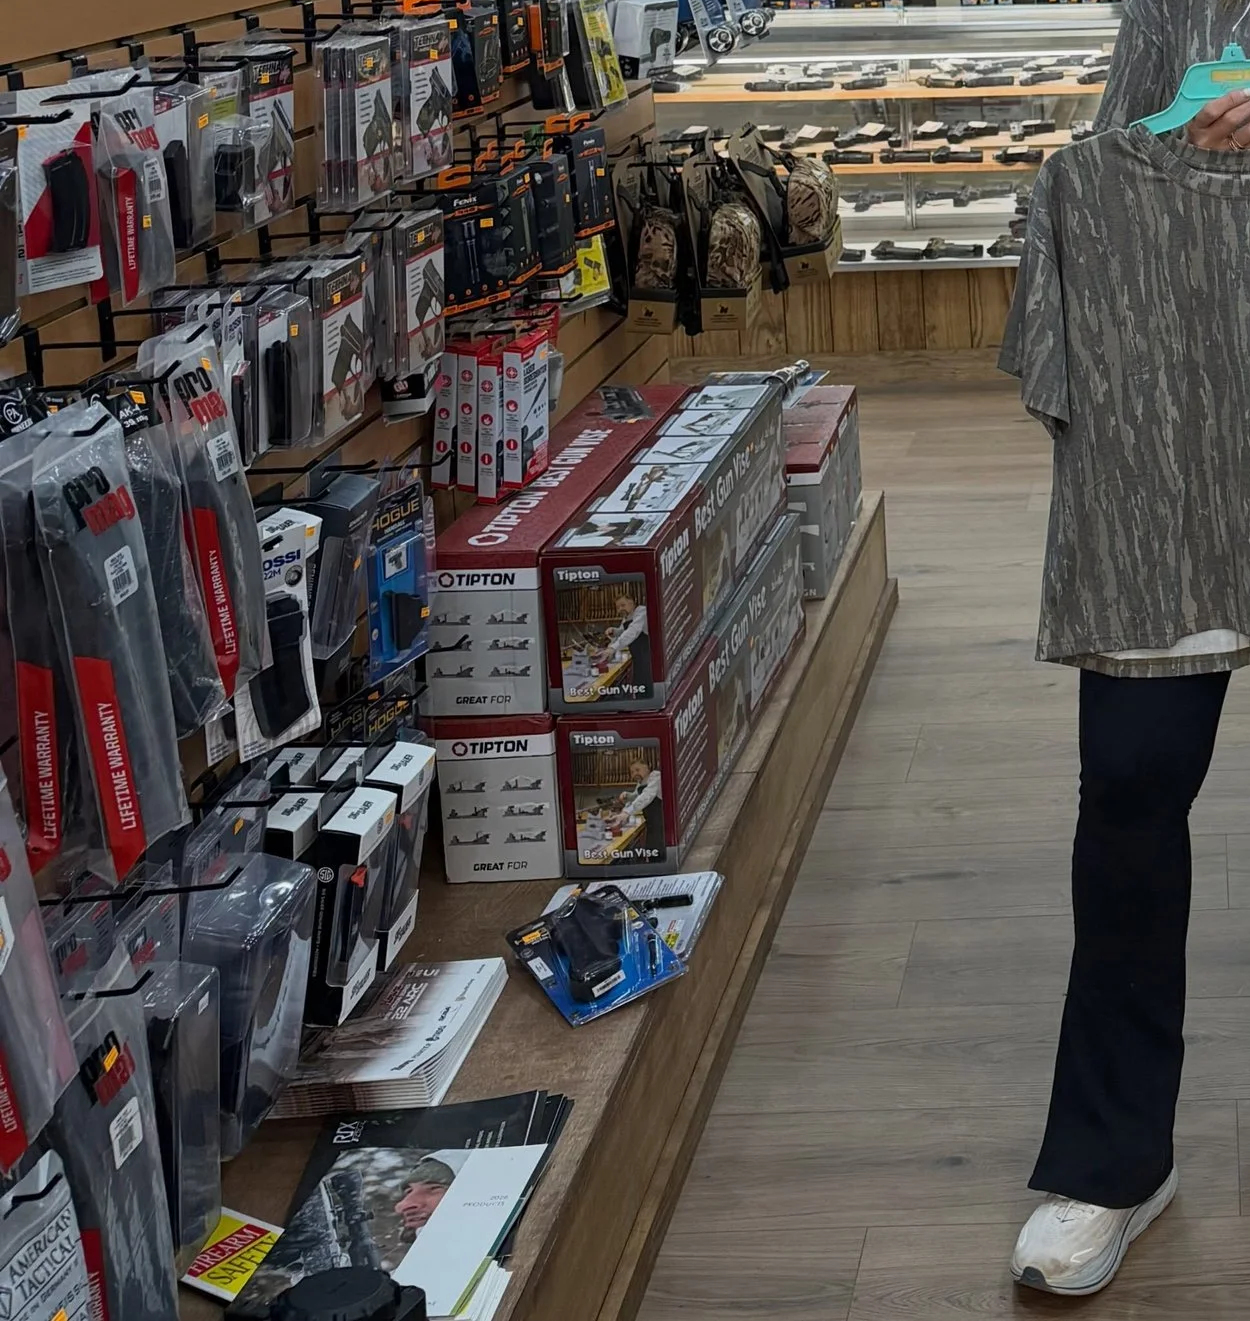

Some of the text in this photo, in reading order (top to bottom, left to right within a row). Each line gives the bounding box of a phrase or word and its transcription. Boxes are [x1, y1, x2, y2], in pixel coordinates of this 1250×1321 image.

[453, 195, 477, 207] Fenix
[125, 197, 136, 270] LIFETIME WARRANTY
[570, 429, 613, 447] VISE
[551, 447, 595, 465] GUN
[482, 491, 549, 533] TIPTON
[660, 446, 751, 579] Tipton Best Gun Vise
[263, 549, 301, 572] OSSI
[456, 573, 515, 587] TIPTON
[557, 569, 600, 582] Tipton
[209, 549, 237, 655] LIFETIME WARRANTY
[674, 585, 767, 741] Tipton Best Gun Vise
[456, 695, 511, 705] GREAT FOR
[569, 687, 594, 697] Best
[597, 686, 620, 696] Gun
[469, 739, 528, 754] TIPTON
[573, 734, 615, 746] Tipton
[35, 711, 57, 839] LIFETIME WARRANTY
[97, 703, 137, 830] LIFETIME WARRANTY
[584, 849, 609, 859] Best
[611, 849, 634, 859] Gun
[473, 861, 528, 872] GREAT FOR
[9, 1207, 72, 1283] AMERICAN
[191, 1228, 261, 1274] FIREARM
[15, 1234, 77, 1303] TACTICAL
[207, 1236, 277, 1285] SAFETY
